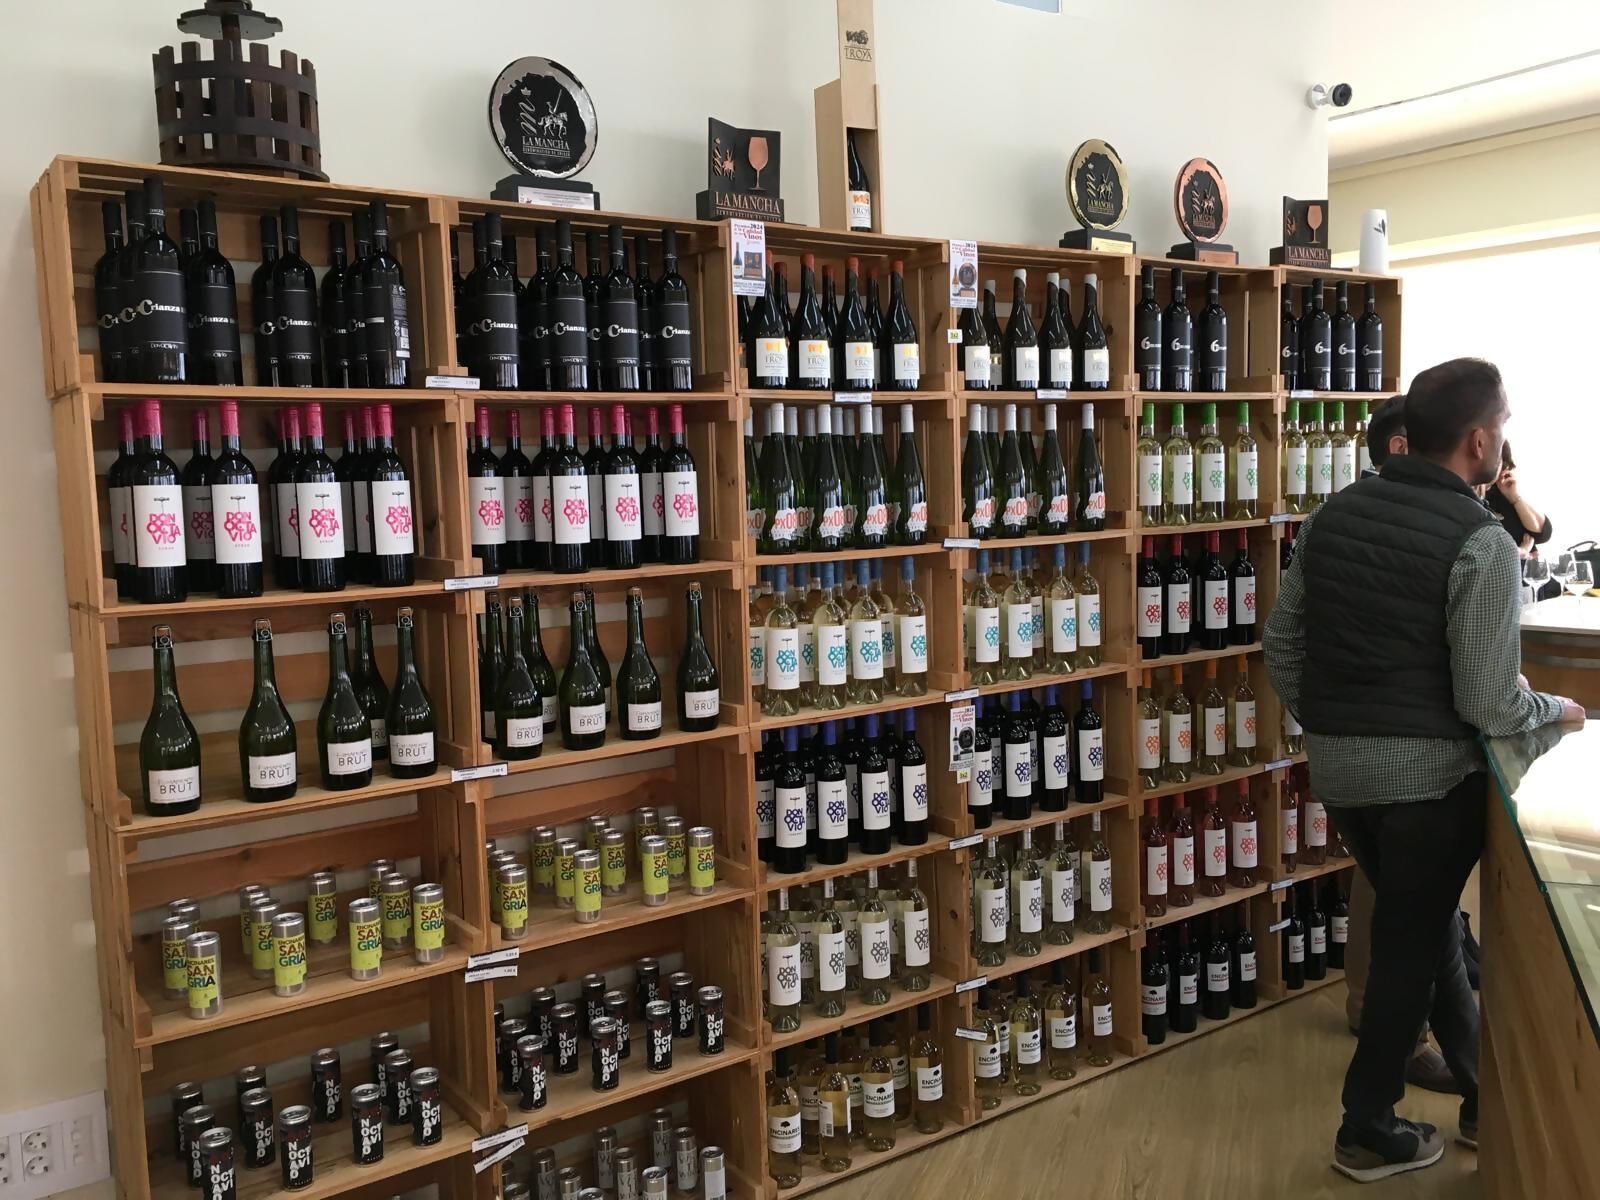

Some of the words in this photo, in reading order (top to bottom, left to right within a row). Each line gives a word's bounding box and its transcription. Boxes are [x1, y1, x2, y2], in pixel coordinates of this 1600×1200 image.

[844, 48, 872, 60] TROYA
[522, 136, 533, 145] LA
[535, 137, 569, 150] MANCHA
[715, 192, 730, 205] LA
[733, 194, 780, 213] MANCHA
[1094, 200, 1113, 209] MANCHA
[1199, 215, 1215, 224] MANCHA
[1288, 246, 1298, 258] LA
[1300, 248, 1328, 259] MANCHA
[136, 300, 180, 315] Crianza
[277, 316, 312, 330] Crianza
[480, 319, 513, 332] Crianza
[554, 322, 584, 335] Crianza
[608, 325, 638, 337] Crianza
[565, 499, 585, 507] DON
[617, 496, 636, 504] DON
[674, 494, 693, 502] DON
[480, 500, 500, 508] DON
[615, 503, 640, 515] OCTA
[673, 500, 696, 512] OCTA
[311, 508, 335, 518] DON
[388, 506, 409, 515] DON
[479, 507, 505, 519] OCTA
[564, 506, 588, 518] OCTA
[678, 510, 694, 519] VIO
[149, 513, 175, 522] DON
[225, 512, 252, 522] DON
[385, 513, 411, 526] OCTA
[484, 517, 501, 526] VIO
[569, 515, 586, 525] VIO
[620, 513, 636, 522] VIO
[775, 512, 796, 529] PX08
[147, 521, 181, 536] OCTA
[223, 520, 257, 534] OCTA
[309, 517, 339, 530] OCTA
[391, 524, 410, 534] VIO
[230, 531, 253, 542] VIO
[315, 527, 336, 538] VIO
[152, 534, 176, 544] VIO
[861, 640, 878, 648] DON
[778, 648, 795, 657] DON
[860, 646, 881, 657] OCTA
[776, 655, 797, 666] OCTA
[864, 655, 878, 663] VIO
[780, 664, 795, 673] VIO
[694, 701, 716, 711] BRUT
[579, 716, 602, 727] BRUT
[637, 712, 660, 723] BRUT
[516, 728, 541, 739] BRUT
[398, 746, 427, 759] BRUT
[338, 754, 368, 767] BRUT
[260, 767, 291, 780] BRUT
[159, 781, 193, 795] BRUT
[828, 800, 844, 808] DON
[875, 805, 888, 814] VIO
[786, 808, 803, 816] DON
[827, 807, 846, 816] OCTA
[784, 815, 805, 824] OCTA
[830, 815, 844, 823] VIO
[787, 823, 803, 831] VIO
[535, 849, 554, 858] SAN
[535, 857, 554, 867] GRIA
[503, 889, 526, 900] SAN
[316, 899, 336, 911] SAN
[386, 898, 410, 910] SAN
[503, 900, 527, 910] GRIA
[316, 910, 337, 922] GRIA
[386, 908, 410, 920] GRIA
[421, 908, 443, 920] SAN
[421, 919, 444, 931] GRIA
[358, 927, 381, 940] SAN
[279, 943, 306, 955] SAN
[358, 938, 382, 951] GRIA
[873, 940, 887, 948] DON
[279, 954, 306, 966] GRIA
[875, 954, 887, 963] VIO
[187, 965, 214, 976] SAN
[779, 966, 796, 975] DON
[188, 976, 215, 988] GRIA
[777, 972, 799, 983] OCTA
[780, 981, 796, 989] VIO
[865, 1092, 893, 1101] ENCINARES
[770, 1126, 800, 1136] ENCINARES
